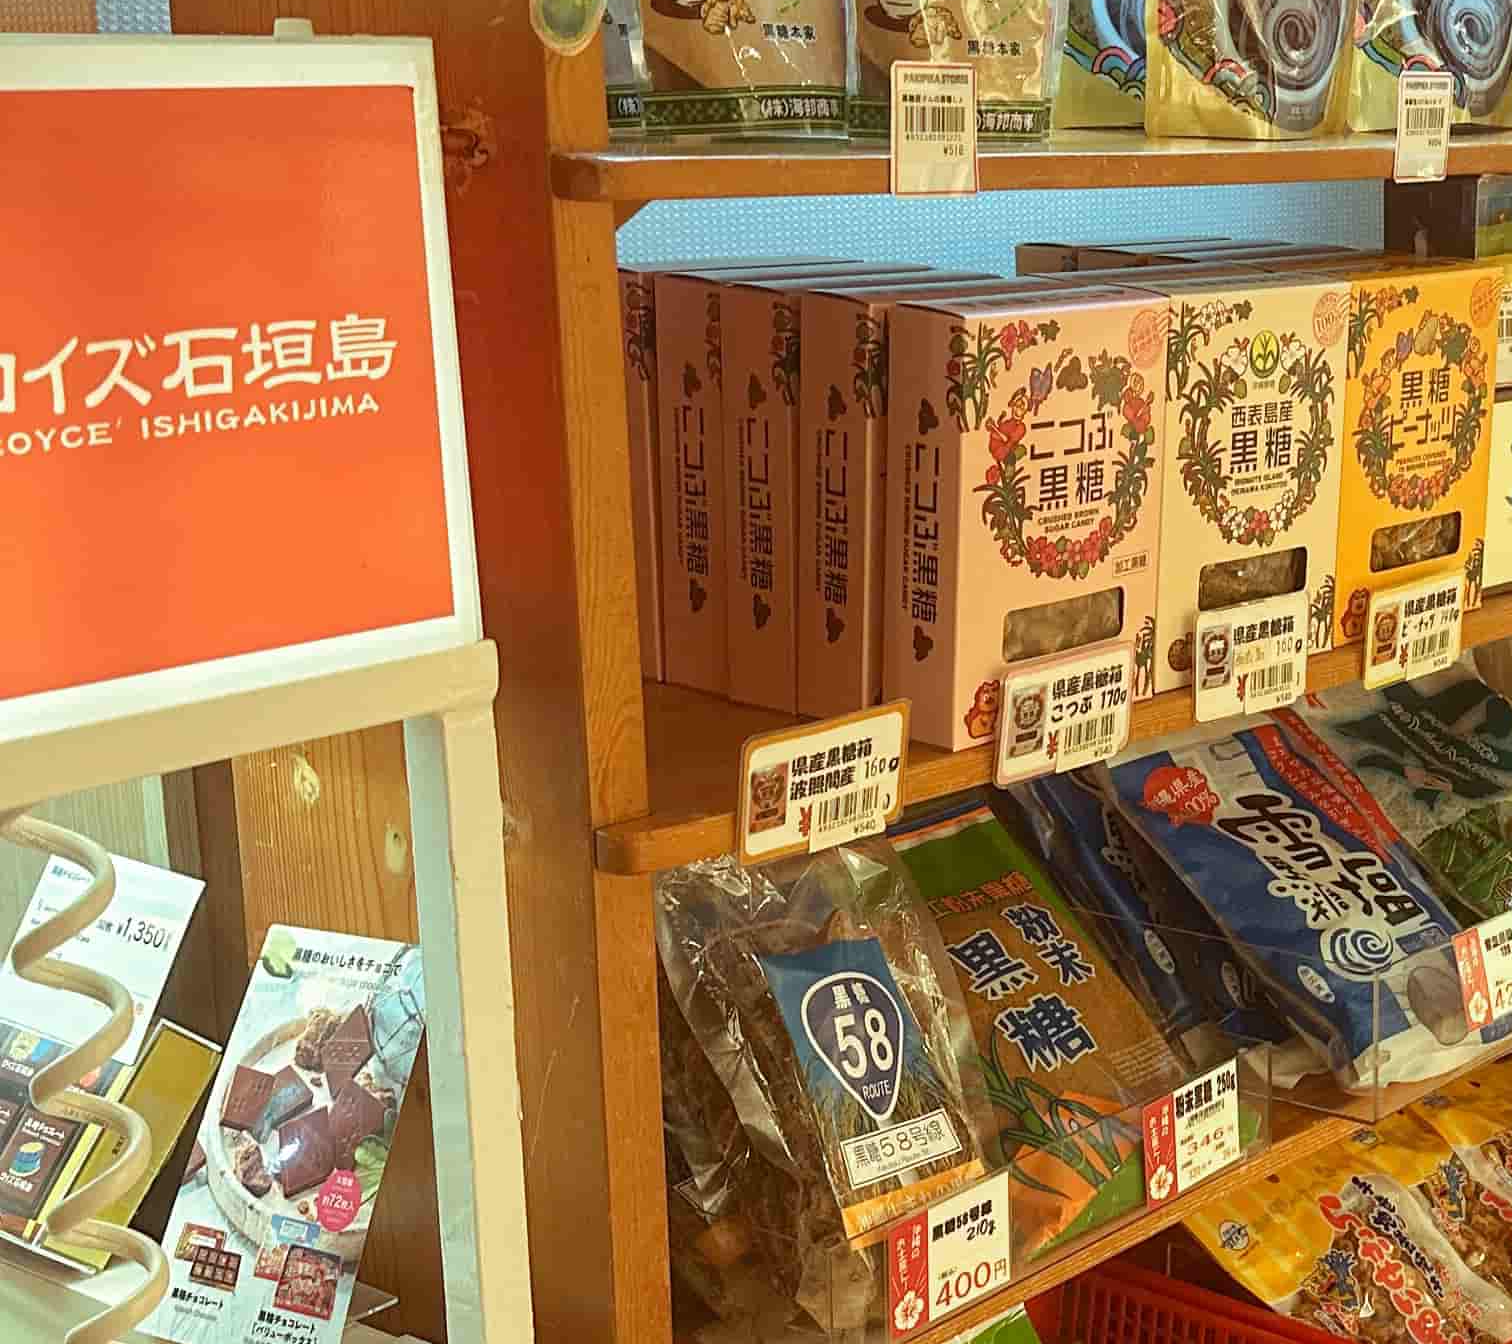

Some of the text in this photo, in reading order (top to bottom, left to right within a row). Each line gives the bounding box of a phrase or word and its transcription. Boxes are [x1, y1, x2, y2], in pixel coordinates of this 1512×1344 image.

[1400, 365, 1451, 410] 黒糖
[139, 391, 381, 440] ISHIGAKIJIMA
[1030, 409, 1114, 460] こつぶ
[1231, 399, 1293, 429] 西表島産
[1386, 405, 1459, 451] ピーナッツ
[1230, 425, 1293, 474] 黒糖
[747, 416, 773, 592] こつぶ黒糖
[1038, 459, 1106, 511] 黒糖
[824, 428, 849, 607] こつぶ黒糖
[911, 442, 939, 624] こつぶ黒糖
[1233, 615, 1295, 646] 県産黒糖箱
[1051, 663, 1124, 701] 県産黒糖箱
[1051, 694, 1094, 723] こつぶ
[791, 737, 873, 777] 県産黒糖箱
[1001, 903, 1096, 986] 粉末
[946, 928, 1098, 1073] 黒糖
[834, 1008, 894, 1080] 58
[862, 1079, 892, 1100] ROUTE
[853, 1121, 945, 1169] 黒糖58号線
[935, 1257, 1008, 1309] 400円
